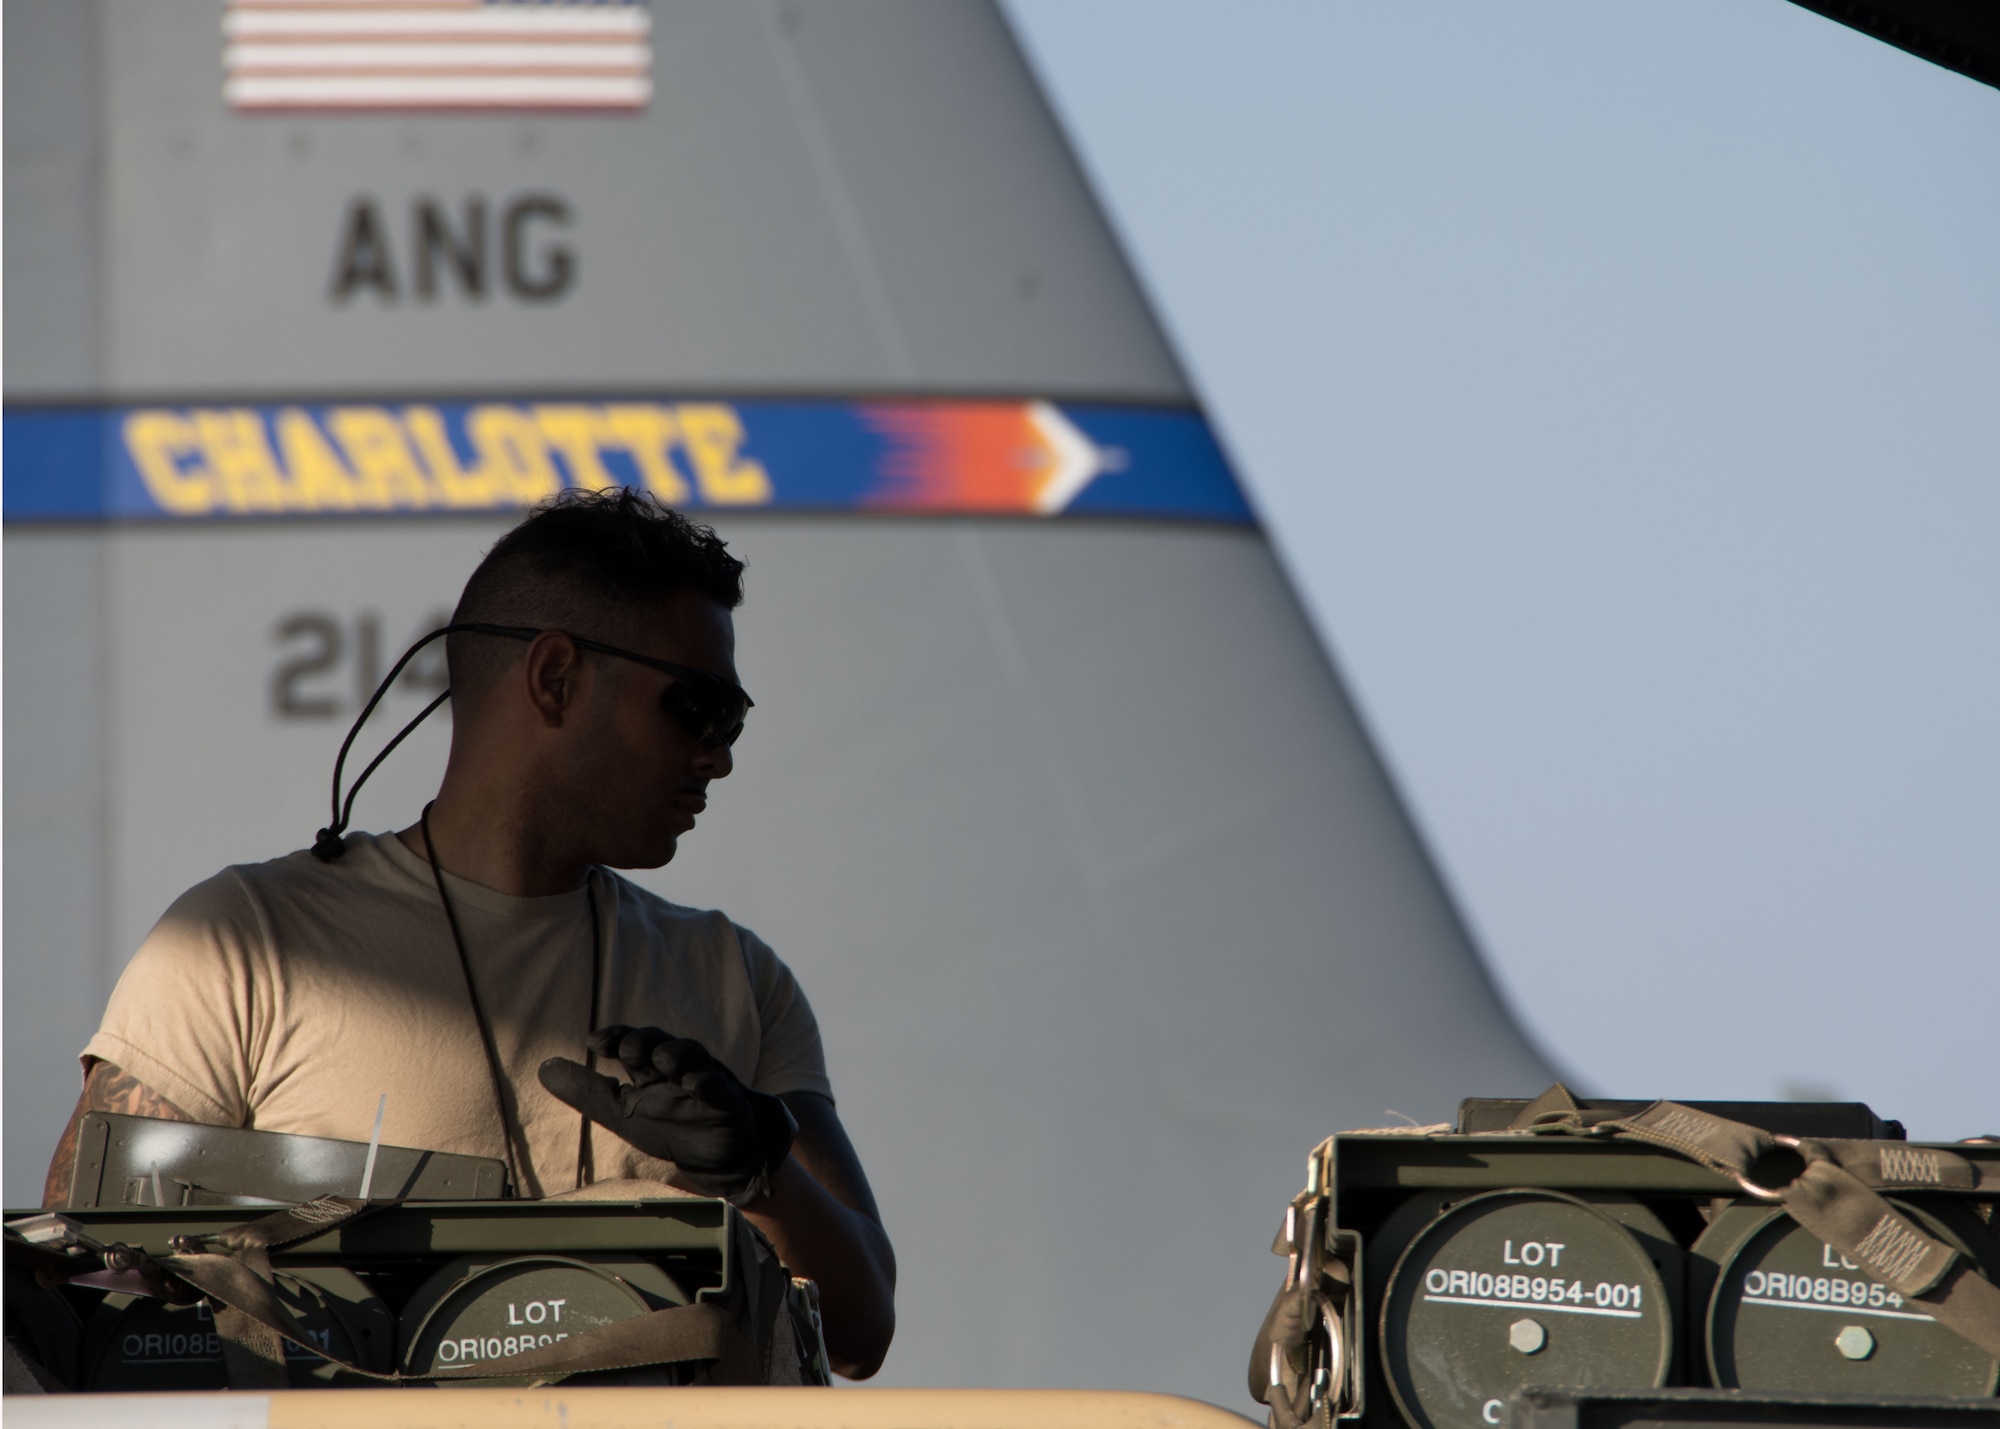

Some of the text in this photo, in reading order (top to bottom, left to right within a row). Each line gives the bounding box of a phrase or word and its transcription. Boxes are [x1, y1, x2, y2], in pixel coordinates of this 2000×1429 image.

[331, 193, 579, 305] ANG
[123, 404, 774, 514] CHARLOTTE
[1503, 1239, 1565, 1267] LOT
[1425, 1268, 1643, 1308] ORI08B954-001
[508, 1299, 567, 1325] LOT
